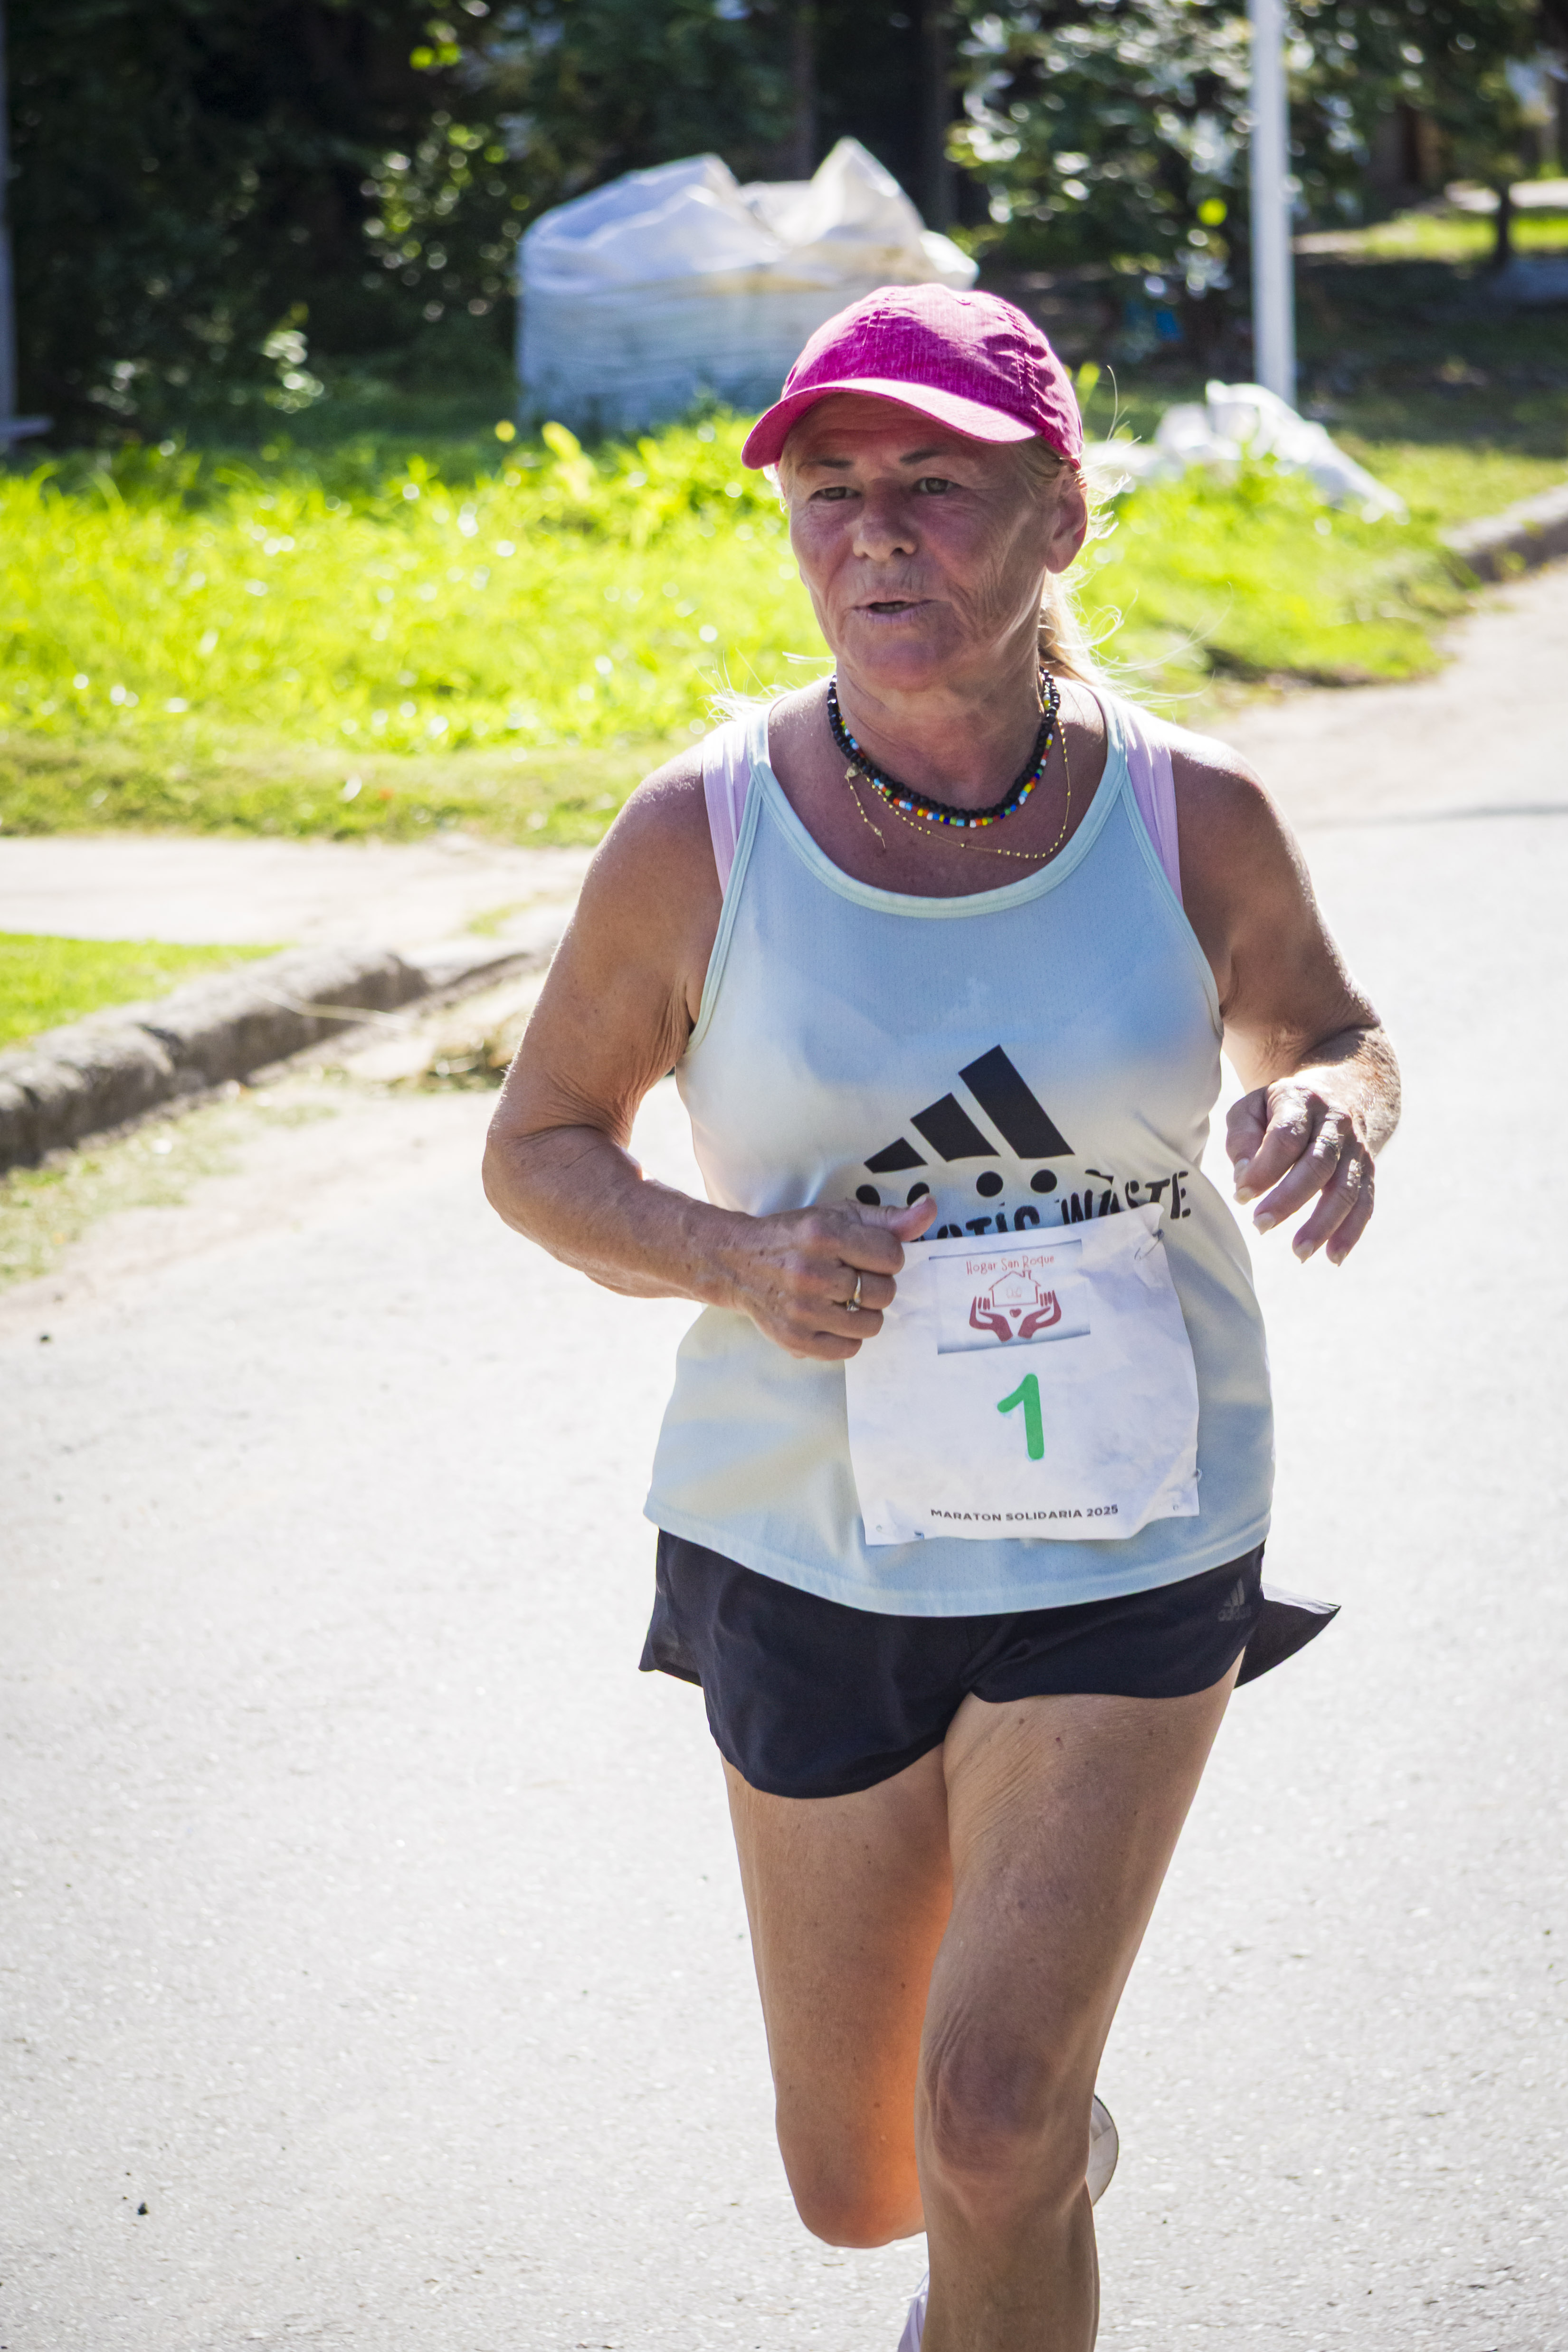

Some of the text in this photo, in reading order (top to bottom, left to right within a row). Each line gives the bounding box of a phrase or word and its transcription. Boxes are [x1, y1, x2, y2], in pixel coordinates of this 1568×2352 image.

[966, 1255, 1055, 1275] Hogar San Roque
[997, 1373, 1045, 1460] 1
[930, 1504, 1118, 1521] MARATON SOLIDARIA 2025
